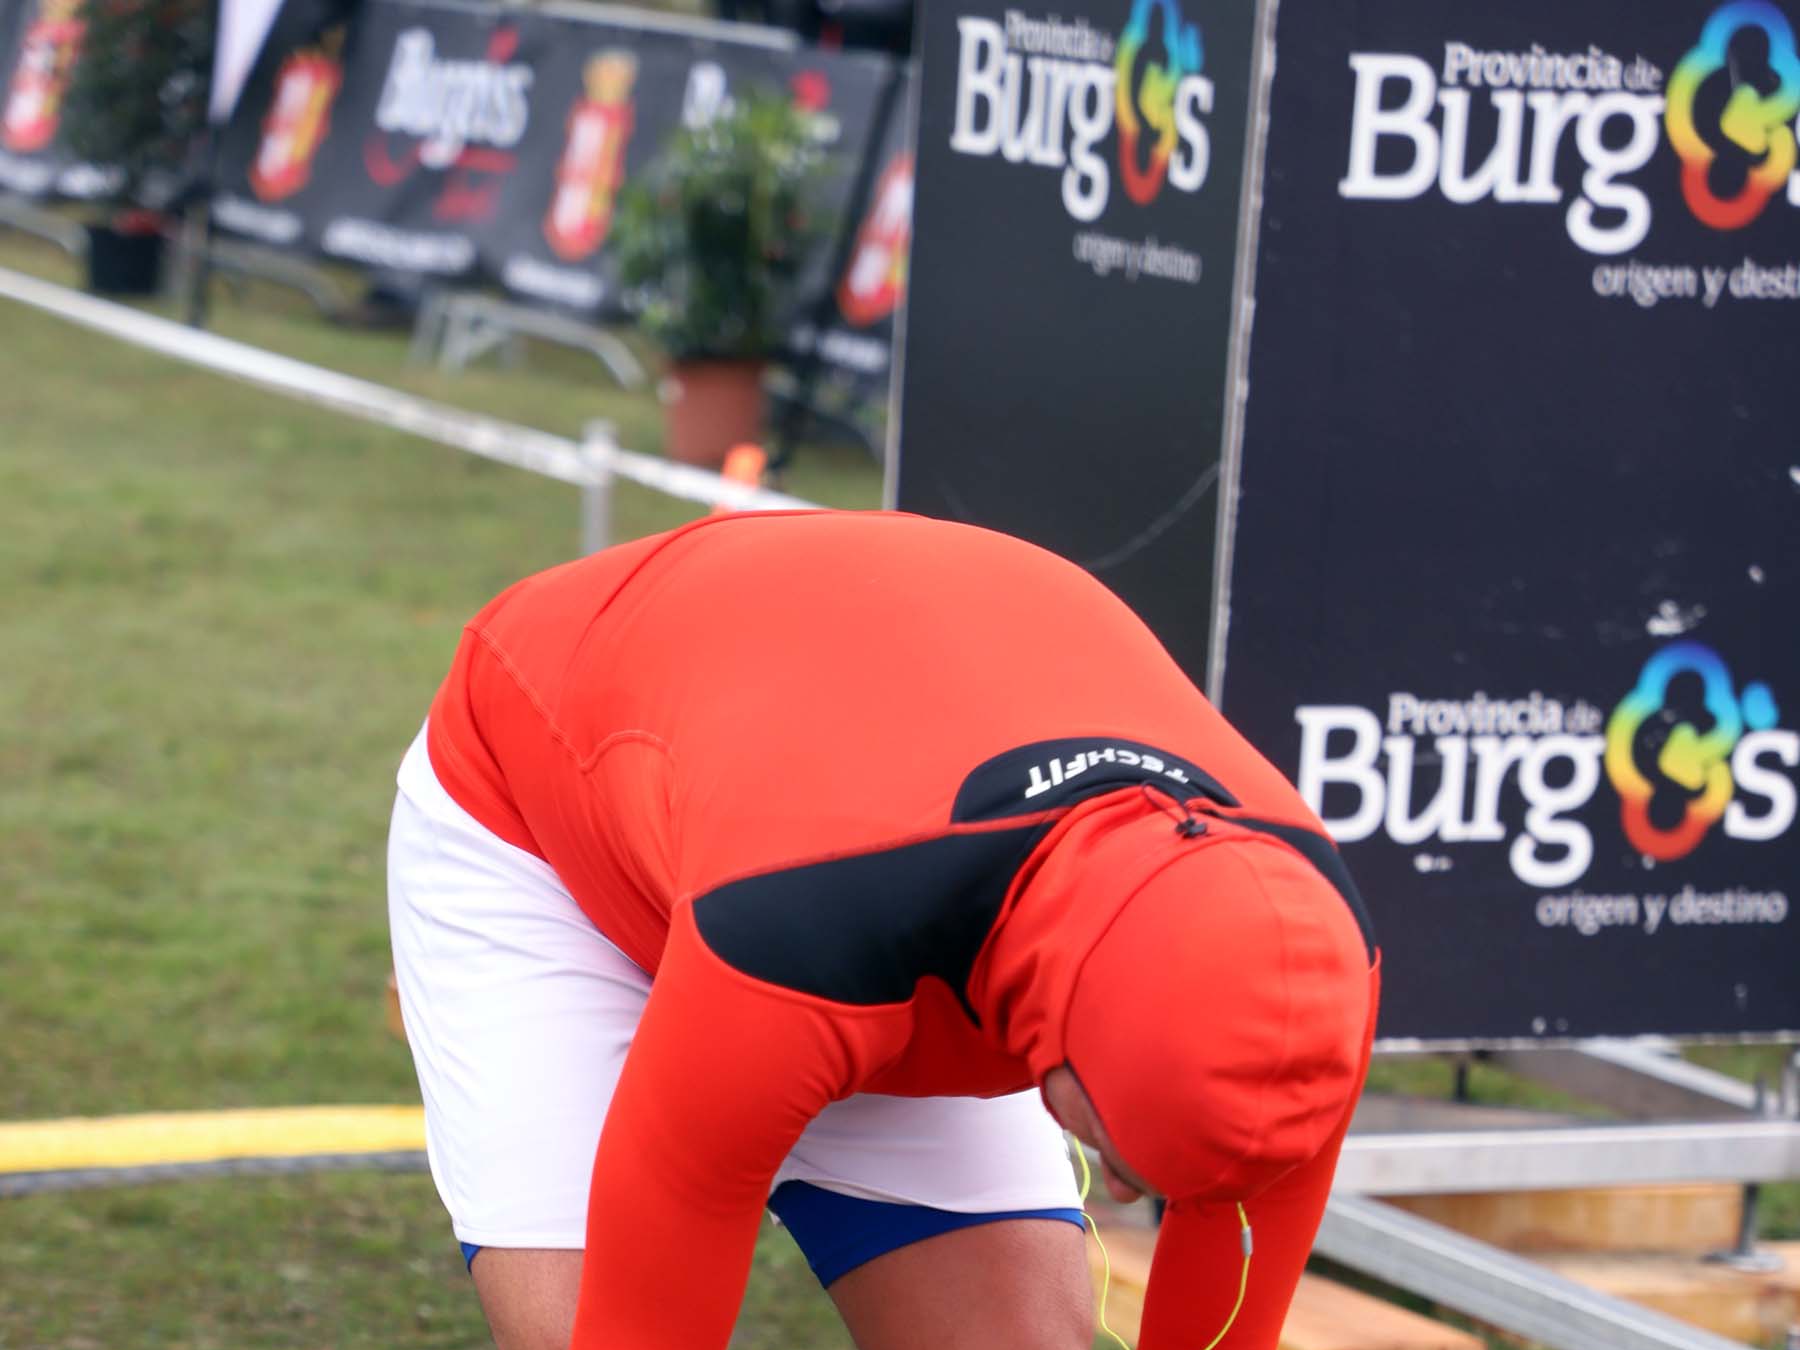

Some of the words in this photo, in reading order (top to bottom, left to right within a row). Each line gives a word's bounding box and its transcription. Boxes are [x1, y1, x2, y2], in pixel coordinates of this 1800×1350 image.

[1444, 41, 1623, 89] Provincia
[1623, 56, 1662, 91] de
[950, 1, 1214, 222] Burgos
[1338, 1, 1800, 255] Burgo
[1592, 257, 1697, 308] origen
[1701, 264, 1727, 309] y
[1388, 691, 1563, 735] Provincia
[1565, 701, 1601, 734] de
[1024, 747, 1189, 799] TECHFIT
[1295, 641, 1800, 888] Burgos
[1536, 889, 1638, 935] origen
[1642, 894, 1668, 934] y
[1669, 886, 1788, 925] destino
